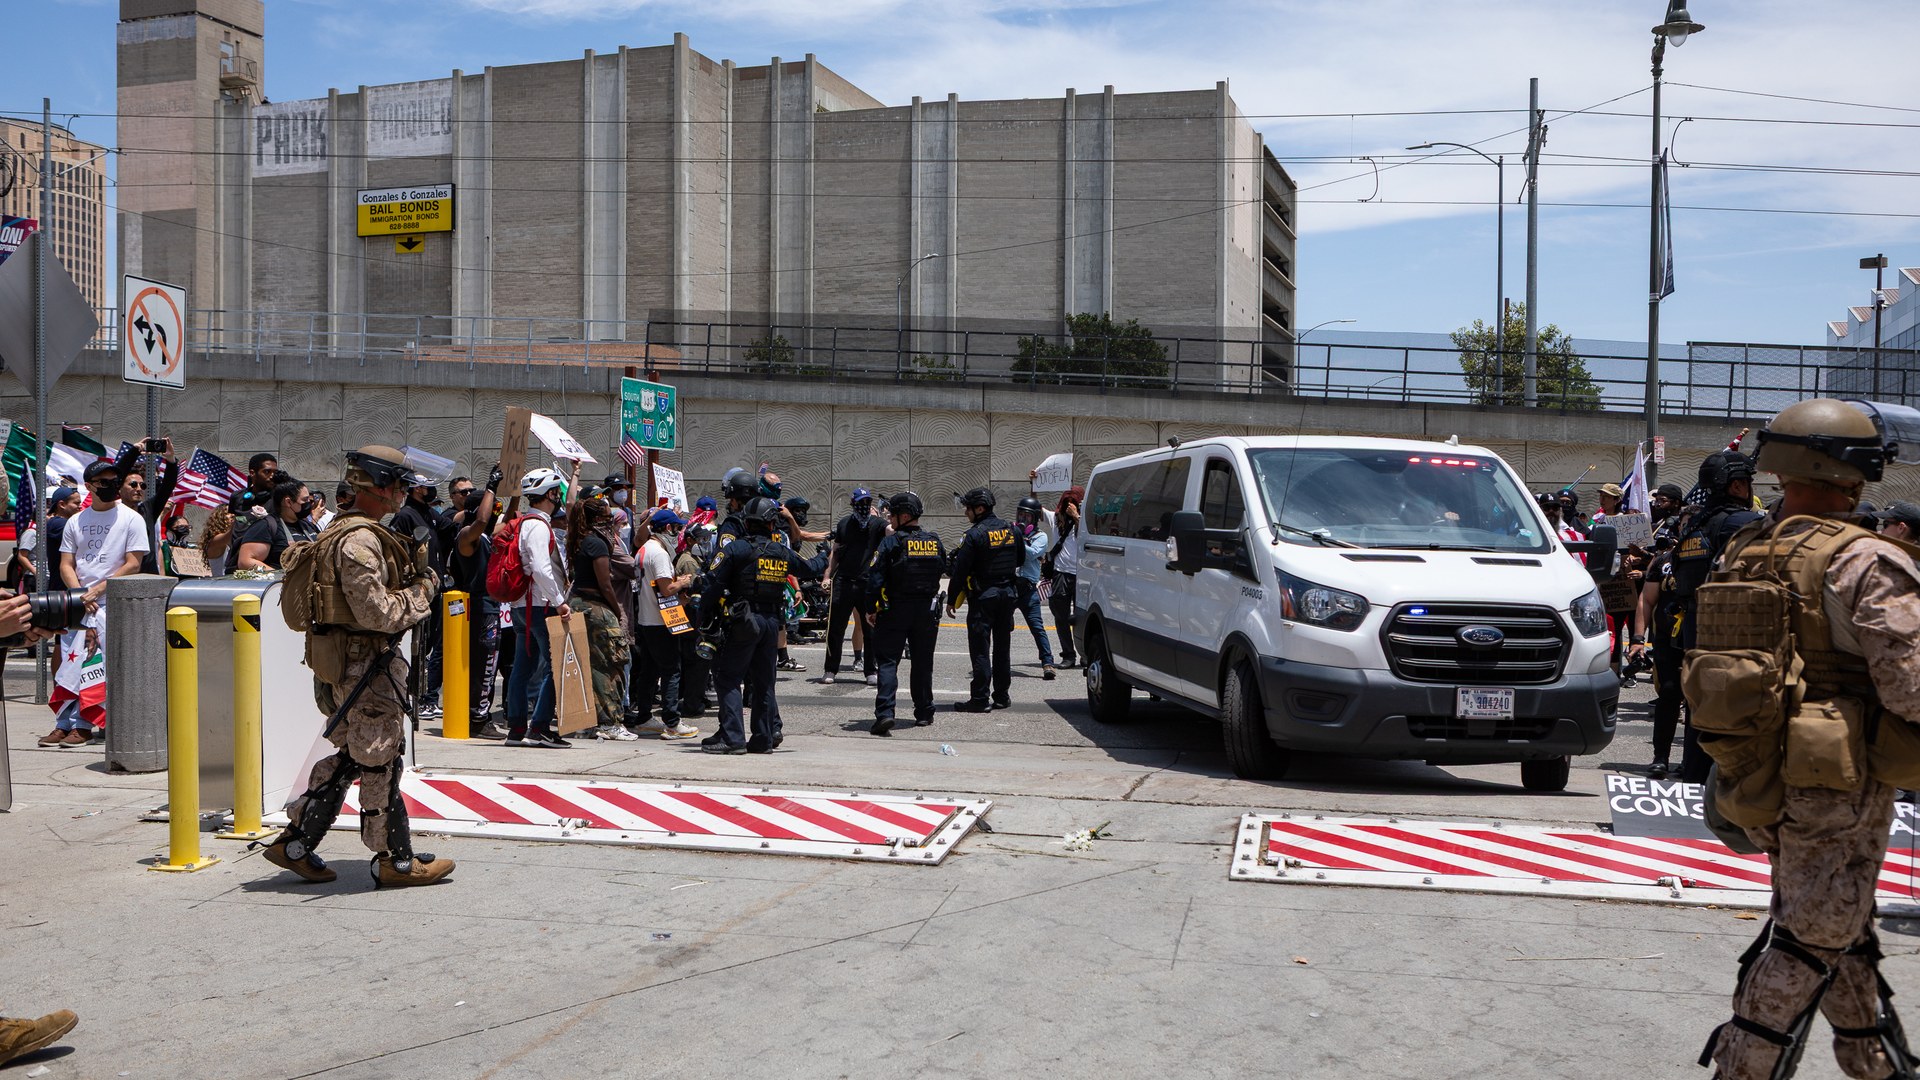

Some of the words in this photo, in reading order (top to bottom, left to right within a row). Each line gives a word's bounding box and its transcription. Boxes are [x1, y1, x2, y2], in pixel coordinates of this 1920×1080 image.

[256, 108, 327, 166] PARK
[362, 192, 399, 203] Gonzales
[401, 191, 407, 200] &
[410, 189, 448, 200] Gonzales
[370, 204, 393, 215] BAIL
[400, 200, 439, 213] BONDS
[370, 214, 412, 223] IMMIGRATION
[416, 212, 439, 220] BONDS
[624, 391, 640, 402] SOUTH
[660, 399, 666, 407] 5
[645, 425, 652, 434] 10
[659, 429, 667, 439] 60
[82, 524, 111, 535] FEDS
[88, 540, 103, 549] GO
[907, 540, 938, 551] POLICE
[758, 558, 788, 572] POLICE
[1477, 696, 1510, 710] 304240
[1608, 775, 1705, 800] REME
